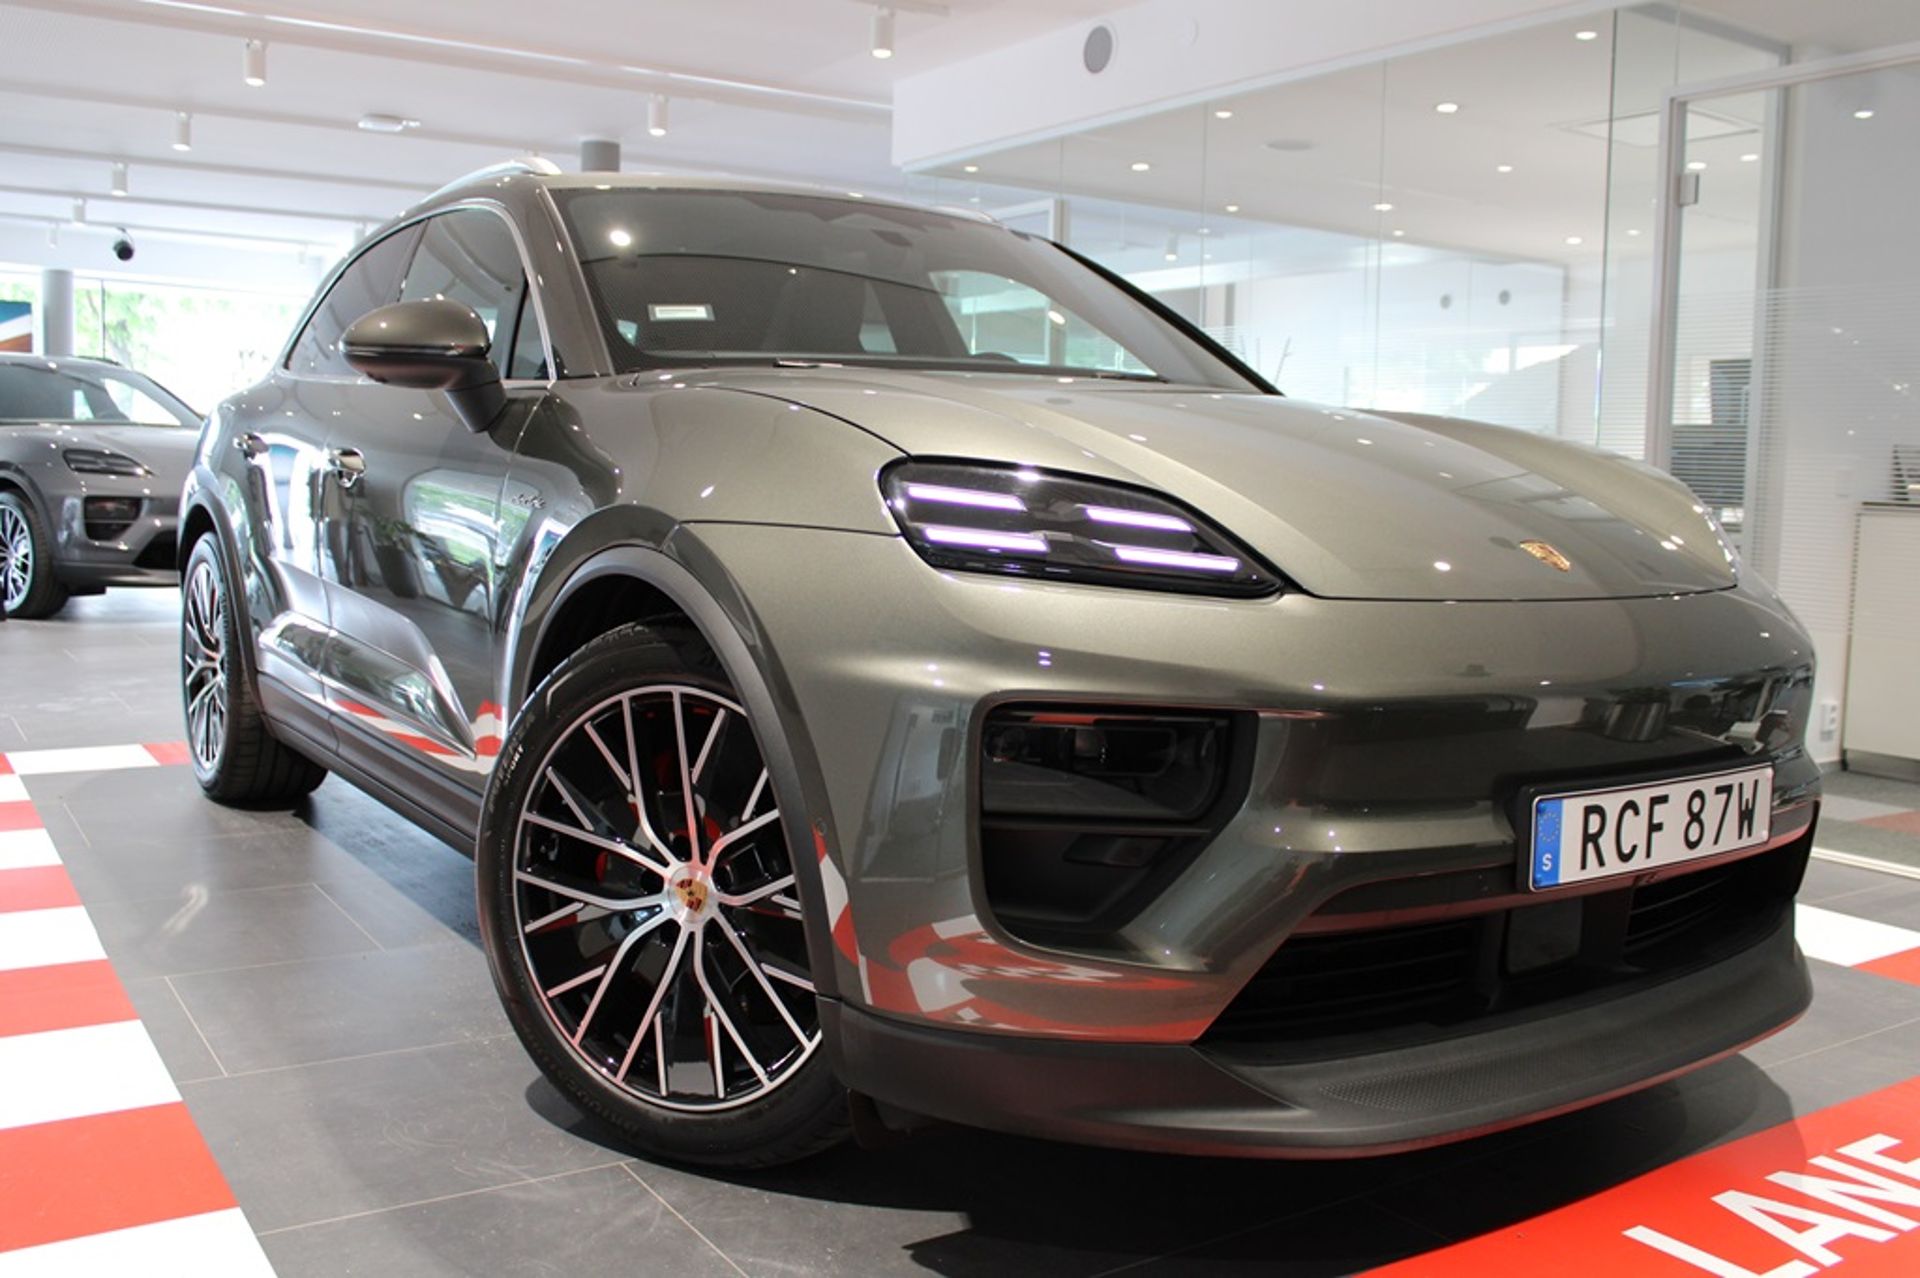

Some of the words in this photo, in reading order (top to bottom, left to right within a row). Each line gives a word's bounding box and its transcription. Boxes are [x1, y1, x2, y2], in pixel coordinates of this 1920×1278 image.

[1580, 794, 1669, 871] RCF
[1683, 779, 1759, 850] 87W
[1542, 853, 1553, 872] S
